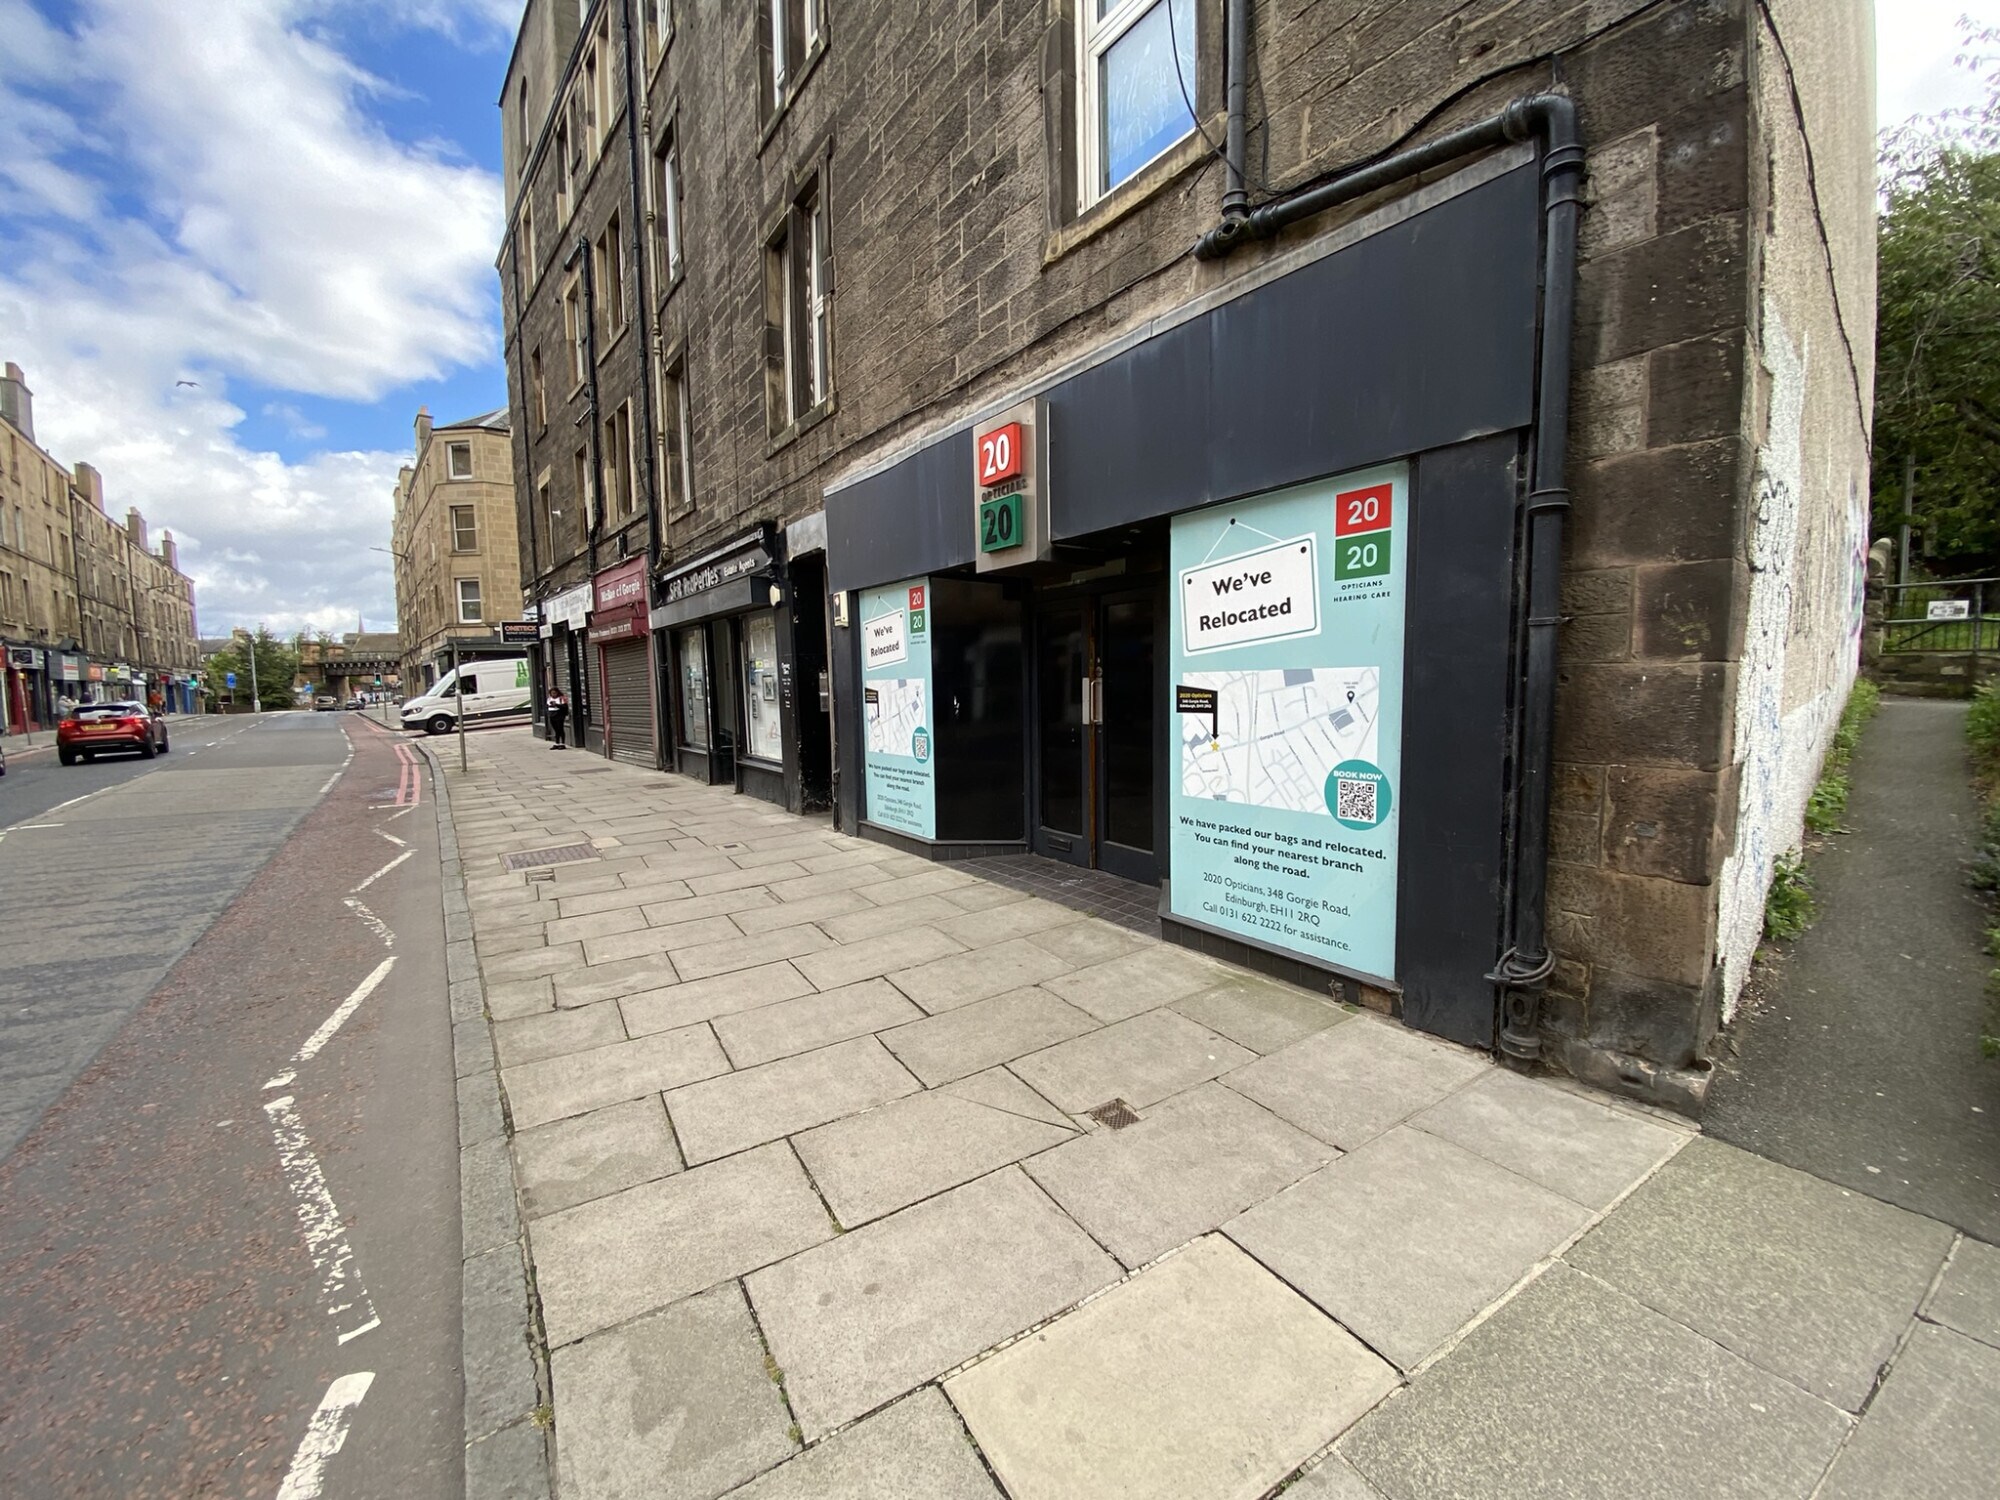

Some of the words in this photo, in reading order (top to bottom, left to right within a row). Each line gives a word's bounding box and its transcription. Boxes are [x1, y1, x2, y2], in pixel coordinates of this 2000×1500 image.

[983, 433, 1010, 478] 20
[982, 479, 1027, 502] OPTICIANS
[1348, 497, 1378, 525] 20
[984, 504, 1012, 545] 20
[739, 558, 755, 572] Agents
[1347, 543, 1378, 569] 20
[622, 579, 640, 595] Gorgie
[1212, 571, 1272, 596] We've
[1341, 580, 1383, 590] OPTICIANS
[912, 592, 922, 605] 20
[1334, 594, 1367, 602] HEARING
[913, 615, 922, 628] 20
[1200, 597, 1292, 631] Relocated
[874, 626, 893, 637] We've
[871, 641, 899, 657] Relocated
[1333, 771, 1358, 779] BOOK
[1360, 772, 1382, 780] NOW
[1180, 816, 1194, 826] We
[1196, 818, 1216, 830] have
[1219, 821, 1251, 837] packed
[1254, 828, 1271, 839] our
[1274, 831, 1298, 846] bags
[1302, 835, 1321, 847] and
[1325, 840, 1386, 860] relocated.
[1194, 833, 1211, 844] You
[1213, 836, 1228, 847] can
[1231, 839, 1249, 852] find
[1252, 843, 1275, 858] your
[1278, 848, 1318, 863] nearest
[1322, 855, 1363, 873] branch
[1234, 855, 1260, 871] along
[1263, 861, 1279, 873] the
[1282, 864, 1310, 879] road.
[1203, 872, 1222, 885] 2020
[1224, 877, 1265, 897] Opticians,
[1267, 886, 1284, 900] 348
[1286, 891, 1318, 909] Gorgie
[1225, 893, 1268, 913] Edinburgh,
[1270, 904, 1294, 919] EH11
[1298, 911, 1320, 926] 2RQ
[1203, 902, 1218, 914] Call
[1220, 905, 1238, 920] 0131
[1242, 911, 1257, 925] 622
[1260, 917, 1281, 933] 2222
[1283, 923, 1297, 935] for
[1300, 928, 1351, 952] assistance.
